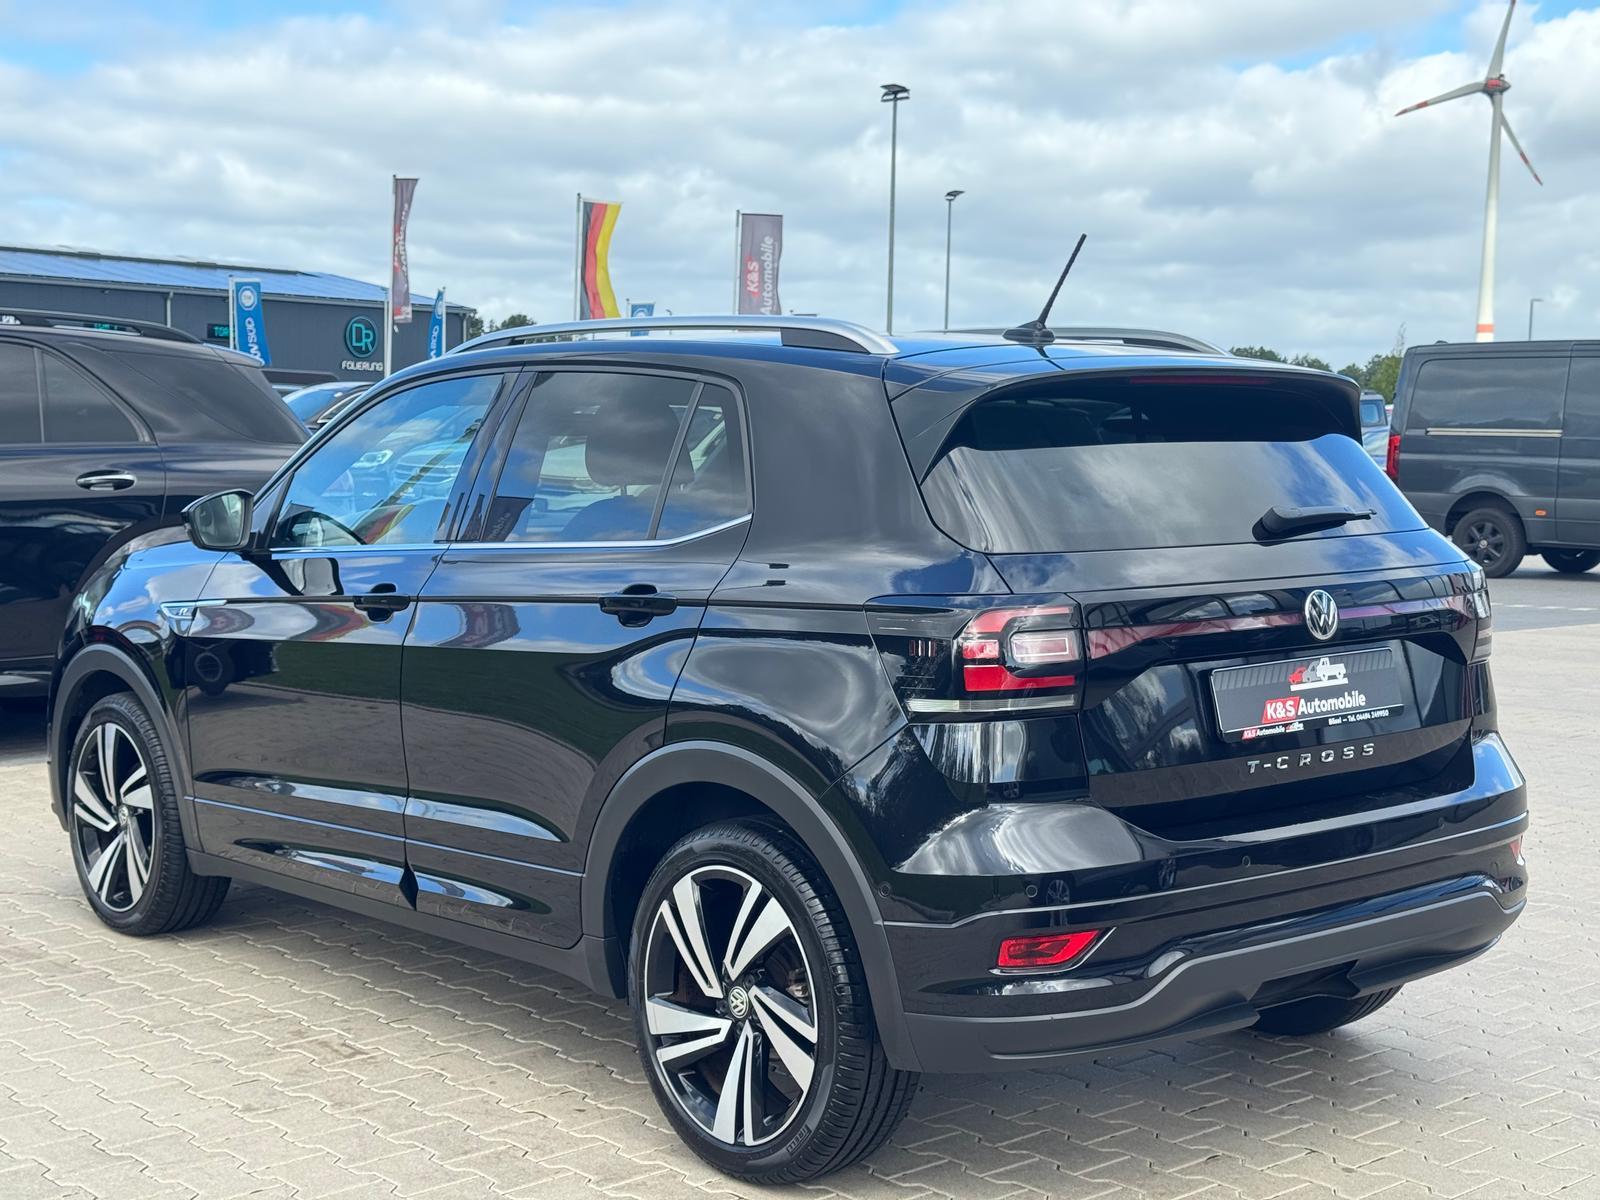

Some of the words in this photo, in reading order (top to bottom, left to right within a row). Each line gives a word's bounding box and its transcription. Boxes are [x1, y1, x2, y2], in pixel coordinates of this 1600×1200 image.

[747, 260, 760, 293] K&S
[760, 234, 774, 315] Automobile
[352, 322, 374, 351] DR
[342, 360, 384, 372] FOLIERUNG
[1265, 700, 1295, 720] K&S
[1298, 690, 1366, 714] Automobile
[1256, 725, 1285, 736] Automobile
[1247, 743, 1375, 774] T-CROSS
